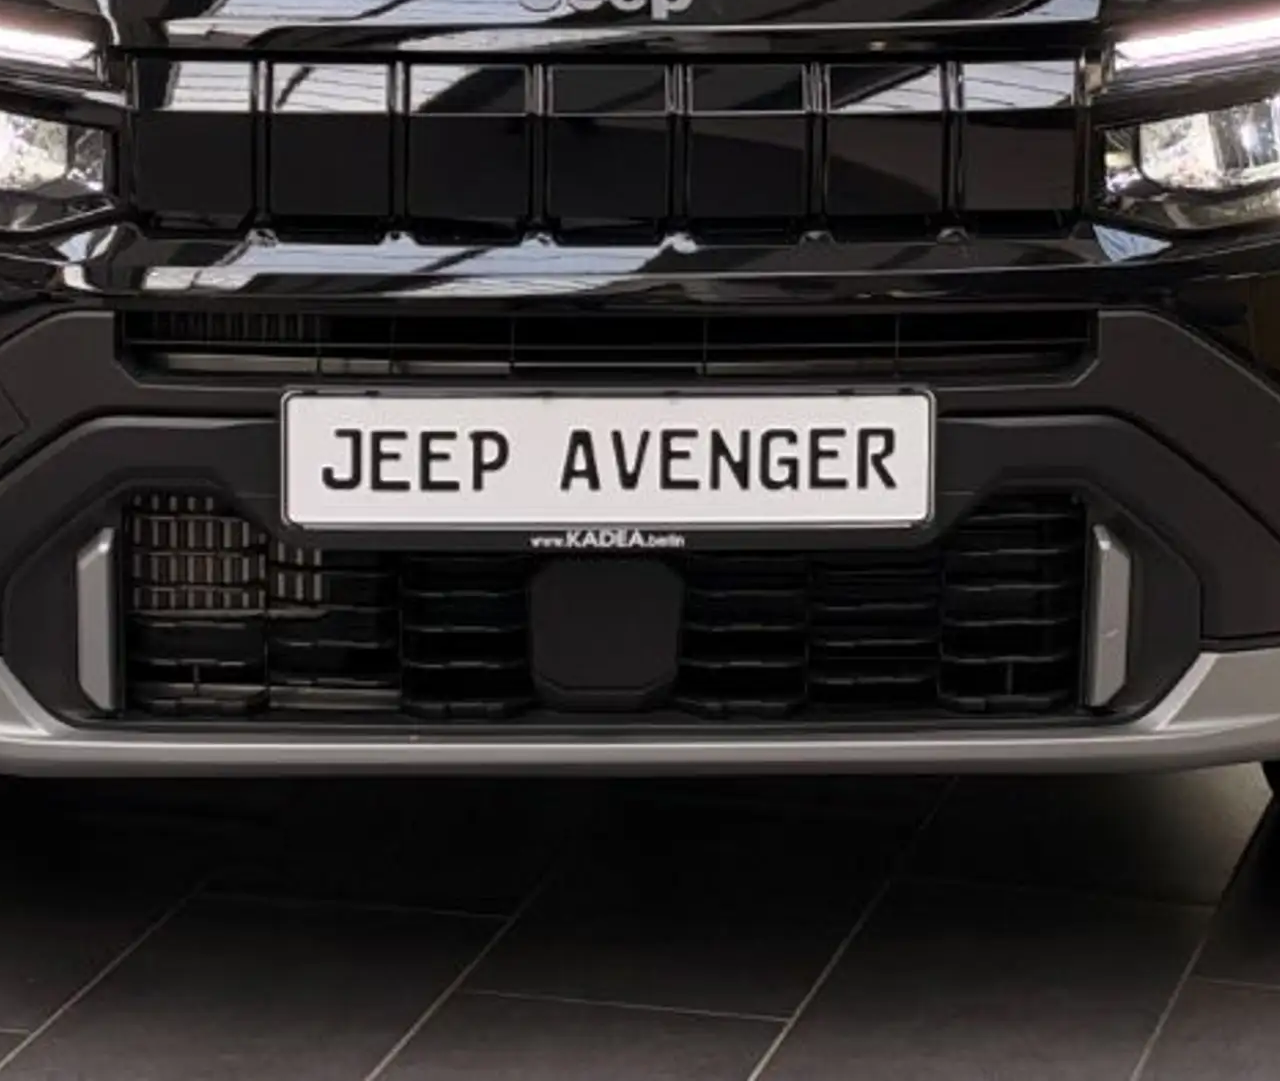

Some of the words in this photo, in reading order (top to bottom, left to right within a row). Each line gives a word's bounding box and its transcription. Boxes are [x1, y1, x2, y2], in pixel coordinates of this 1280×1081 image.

[320, 428, 510, 491] JEEP
[559, 427, 898, 491] AVENGER
[529, 528, 686, 548] www.KADEA.berlin
